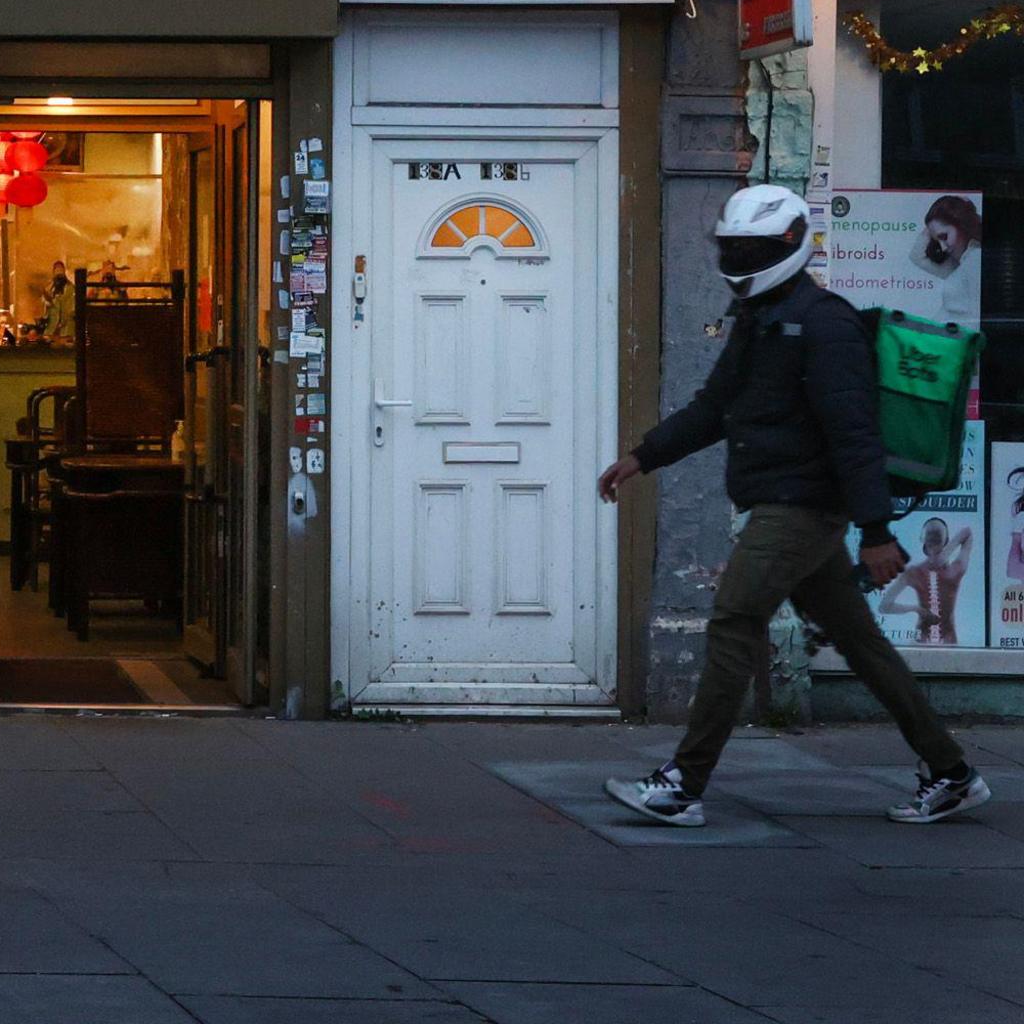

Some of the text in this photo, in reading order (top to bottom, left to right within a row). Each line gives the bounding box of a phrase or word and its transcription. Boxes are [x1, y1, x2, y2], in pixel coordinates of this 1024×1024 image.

[408, 162, 461, 180] 138A
[832, 244, 885, 260] ibroids
[831, 272, 934, 289] ndometriosis
[1000, 637, 1019, 647] BEST
